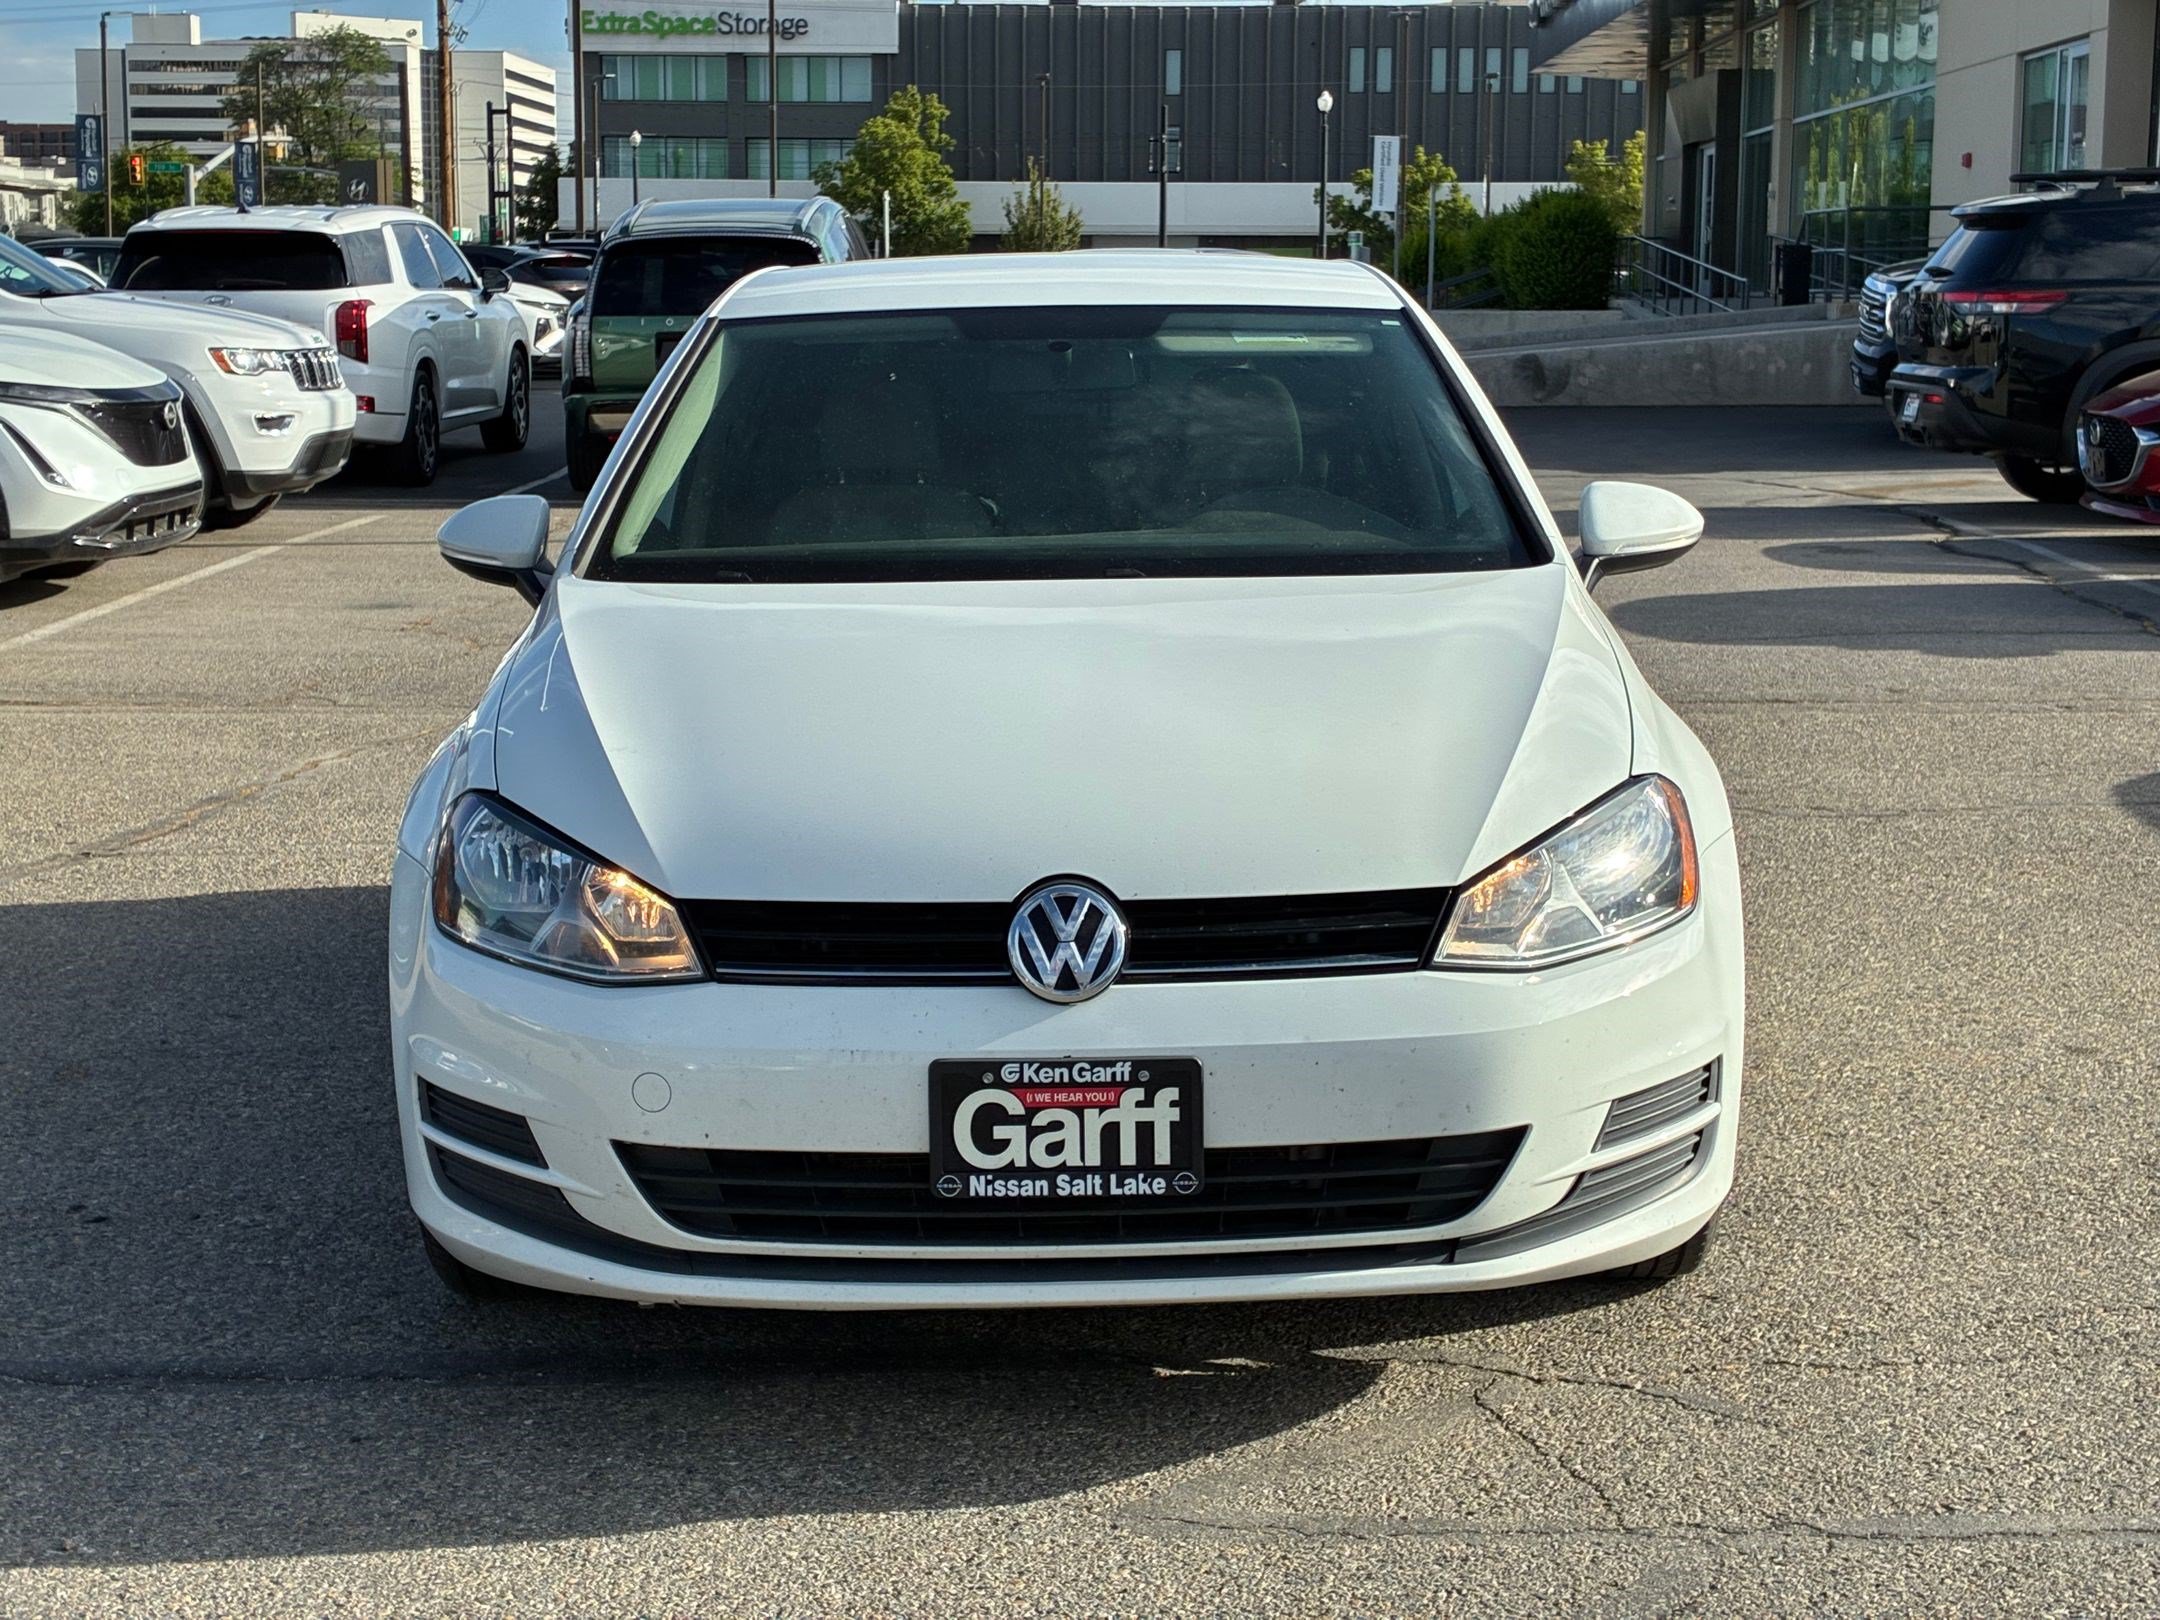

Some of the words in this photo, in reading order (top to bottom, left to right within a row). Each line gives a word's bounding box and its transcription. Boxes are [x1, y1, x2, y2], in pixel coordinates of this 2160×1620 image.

[1023, 1063, 1069, 1083] Ken
[1072, 1062, 1132, 1083] Garff
[1035, 1093, 1052, 1102] WE
[1054, 1093, 1083, 1102] HEAR
[1085, 1092, 1107, 1102] YOU
[953, 1087, 1180, 1169] Garff
[969, 1175, 1049, 1197] Nissan
[1056, 1174, 1102, 1196] Salt
[1110, 1173, 1166, 1195] Lake
